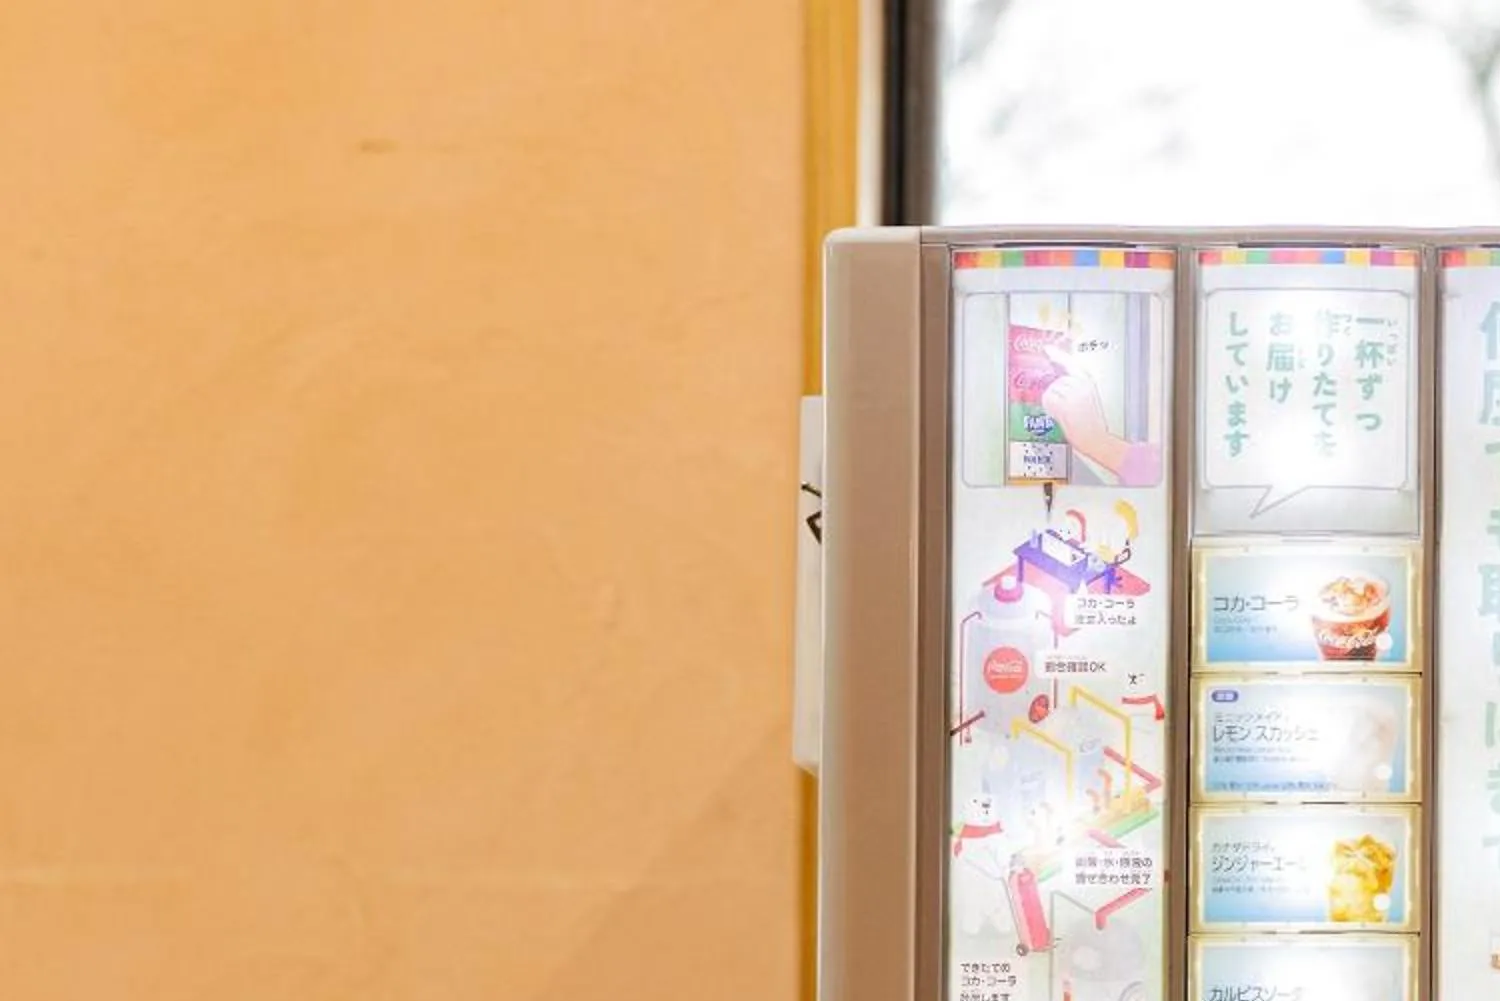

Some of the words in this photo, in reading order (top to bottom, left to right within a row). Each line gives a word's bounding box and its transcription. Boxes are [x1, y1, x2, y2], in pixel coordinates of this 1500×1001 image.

[1265, 311, 1295, 405] お届け
[1355, 316, 1386, 432] 一杯ずつ
[1223, 311, 1250, 458] しています
[1077, 597, 1136, 610] コカ・コーラ
[1213, 596, 1300, 613] コカ・コーラ
[959, 962, 1012, 974] できたての
[959, 975, 1018, 987] コカ・コーラ
